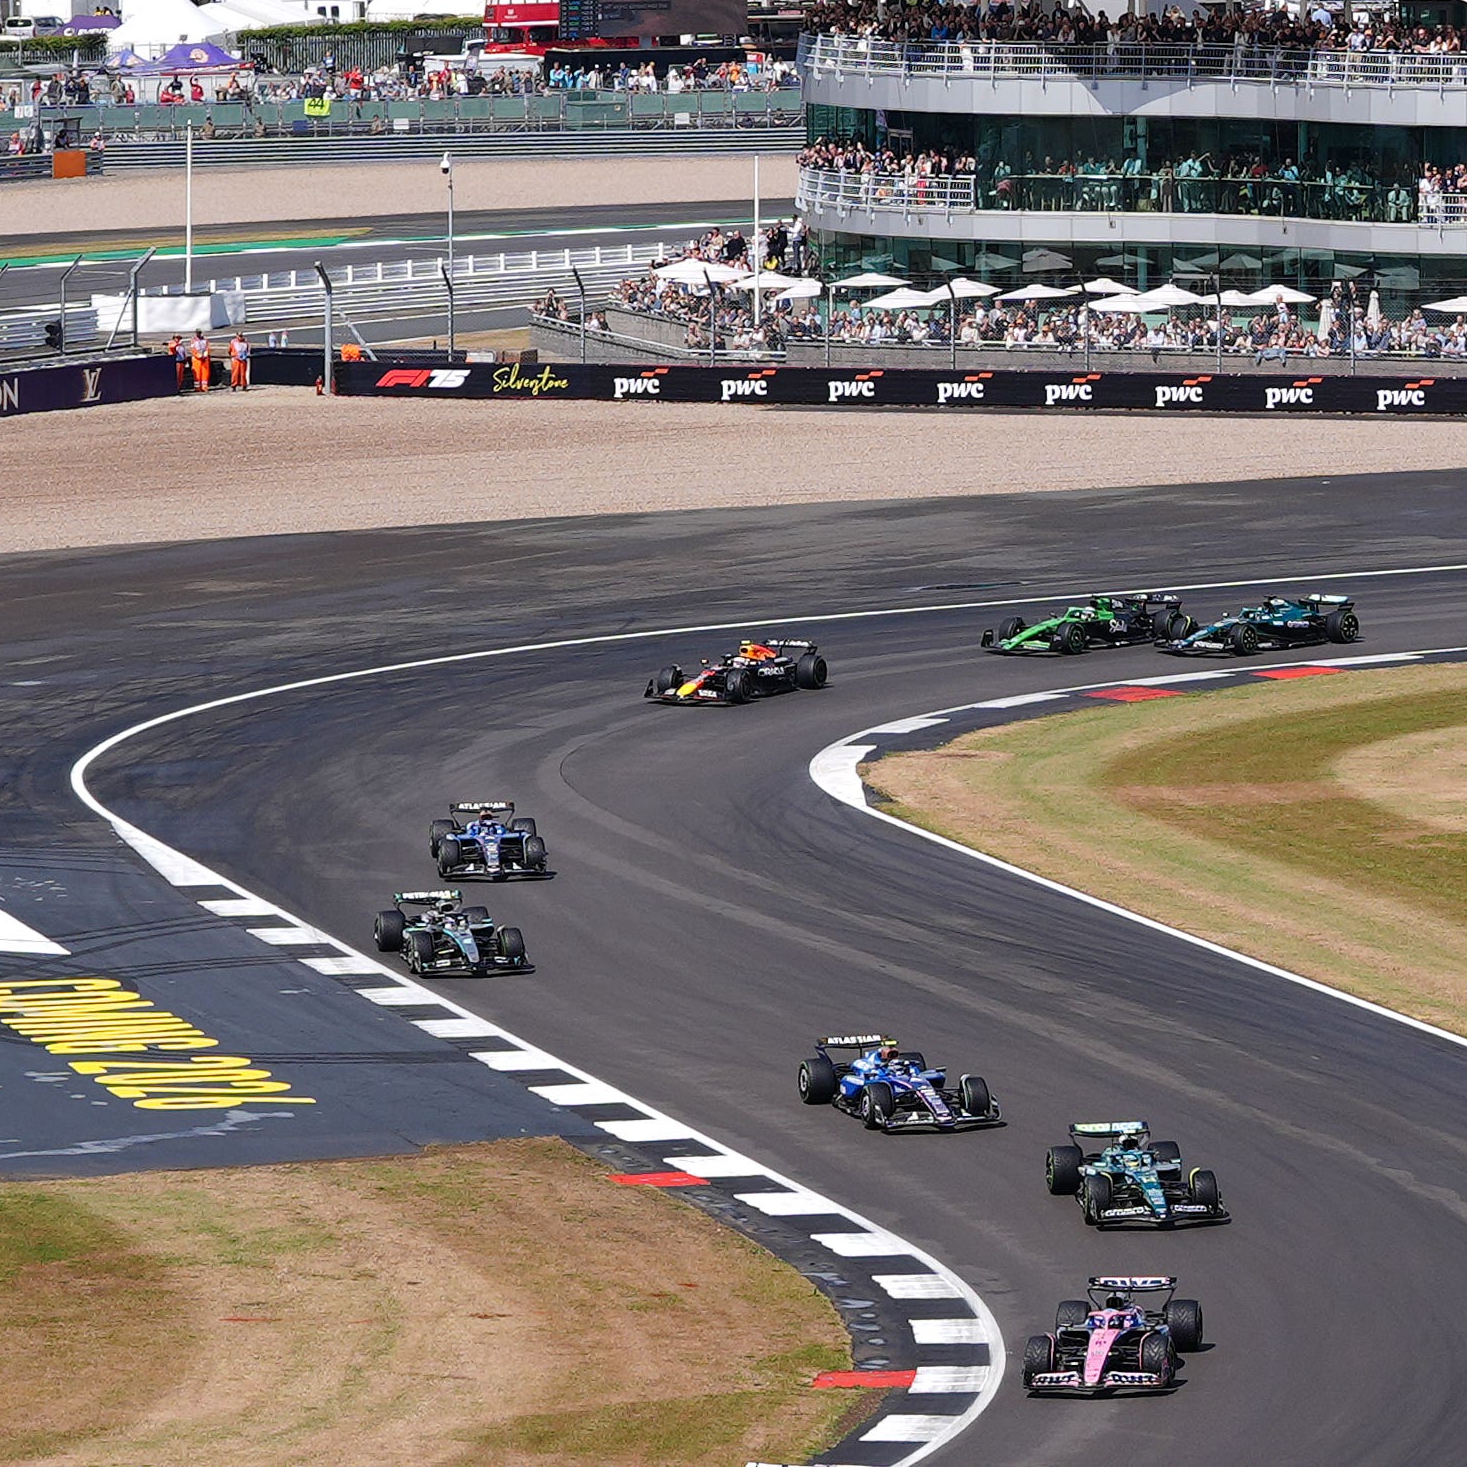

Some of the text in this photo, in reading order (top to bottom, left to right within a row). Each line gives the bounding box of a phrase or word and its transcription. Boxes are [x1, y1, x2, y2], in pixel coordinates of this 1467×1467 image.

[308, 98, 325, 110] 44
[375, 369, 432, 388] F1
[613, 377, 660, 399] pwc
[720, 379, 768, 401] pwc
[827, 380, 875, 402] pwc
[936, 382, 984, 403] pwc
[1044, 384, 1093, 405] pwc
[1154, 385, 1203, 407] pwc
[1264, 387, 1314, 409] pwc
[1376, 389, 1425, 411] pwc
[68, 1056, 316, 1110] 2026
